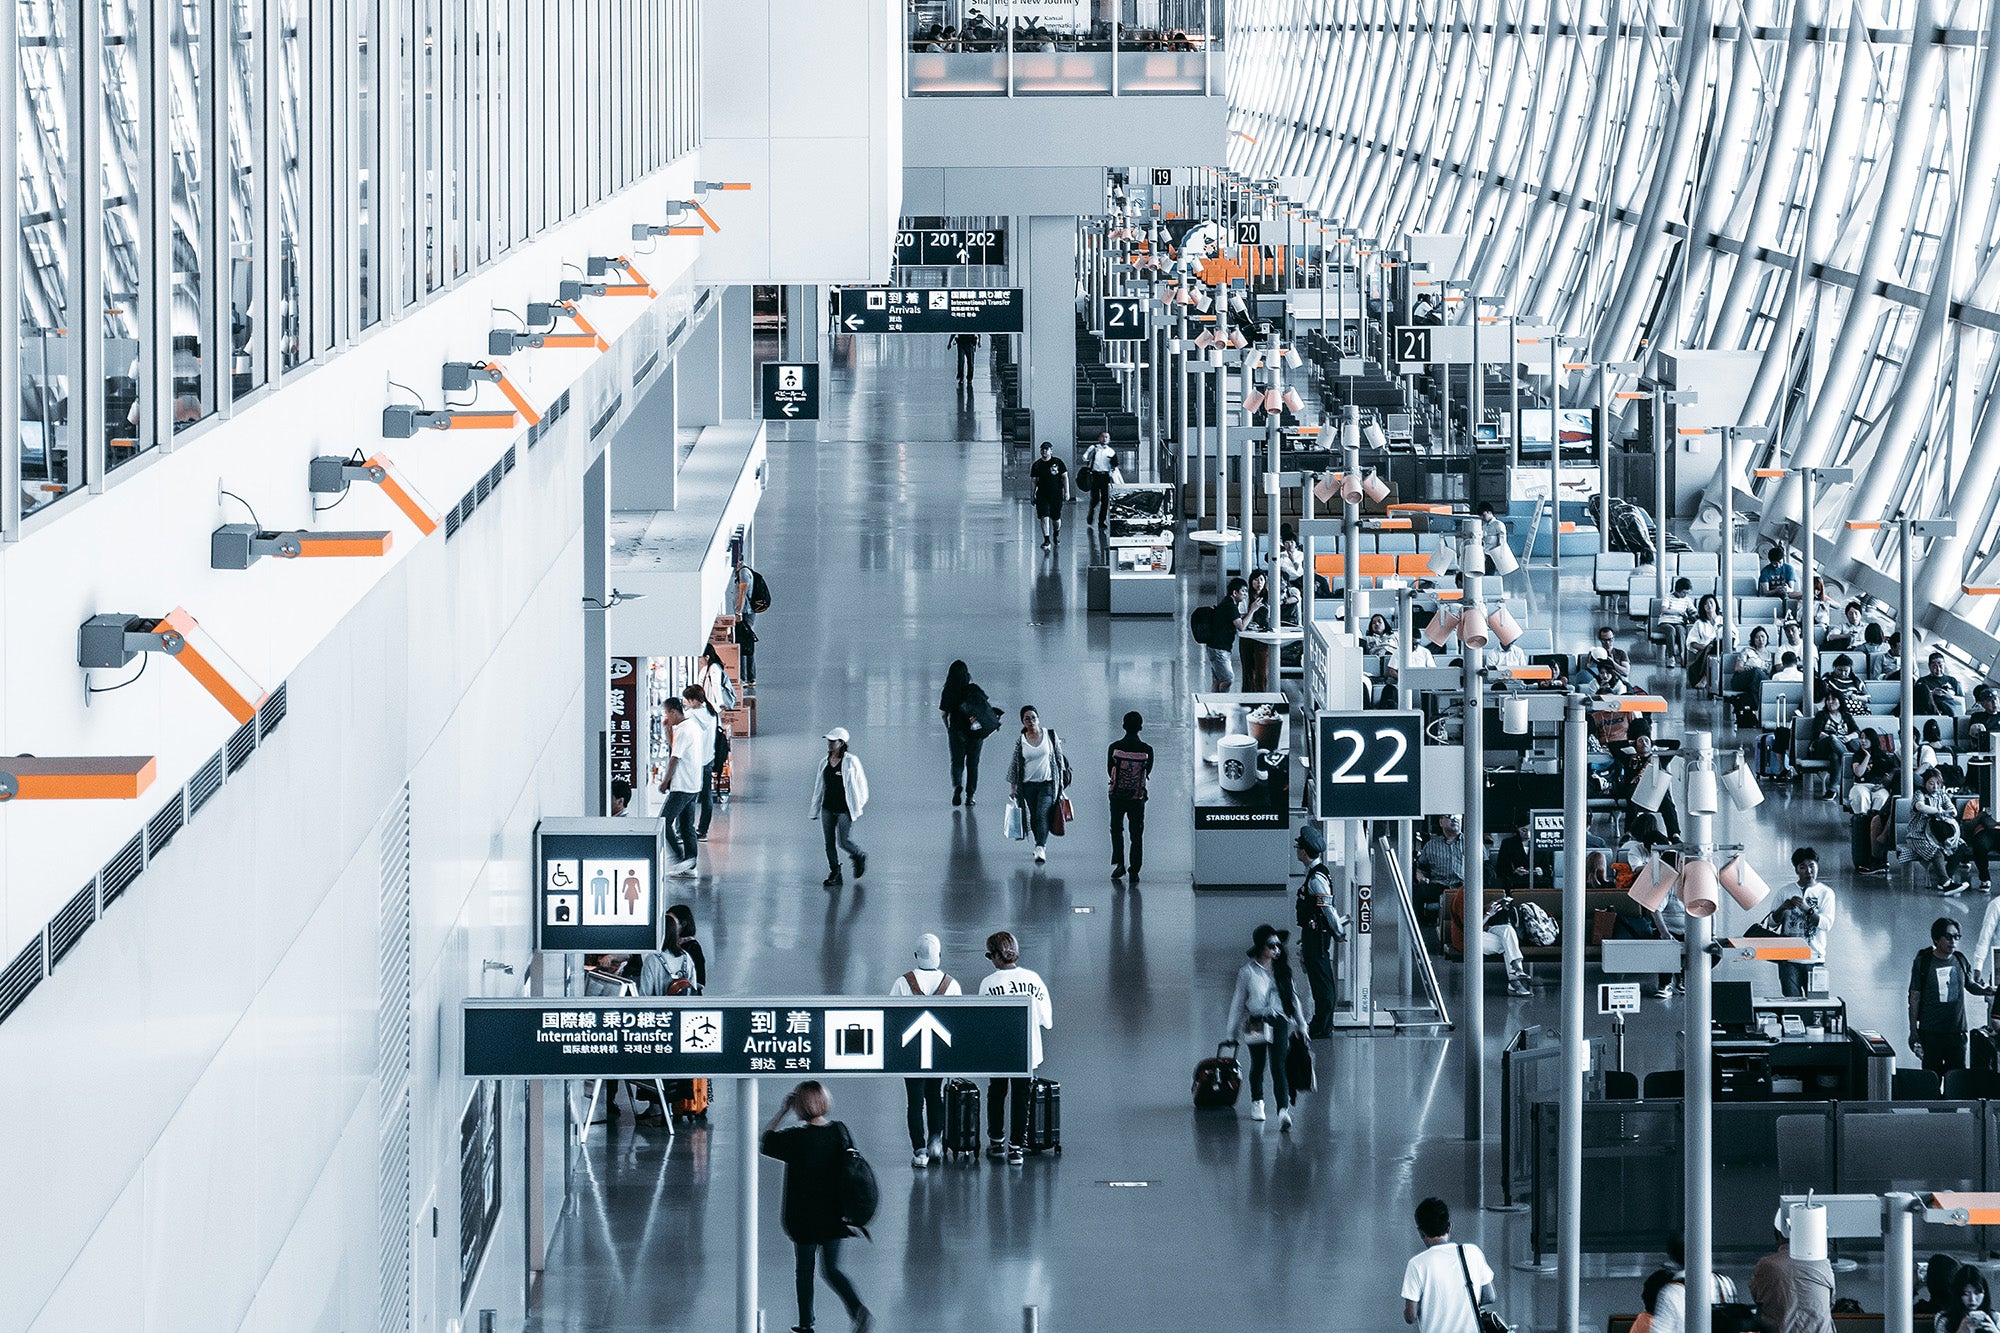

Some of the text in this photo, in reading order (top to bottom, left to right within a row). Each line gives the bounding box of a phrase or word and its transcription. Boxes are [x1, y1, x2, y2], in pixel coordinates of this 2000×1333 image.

[1157, 171, 1169, 184] 19
[1241, 224, 1257, 242] 20
[889, 305, 922, 314] Arrivals
[1109, 303, 1139, 327] 21
[1404, 332, 1425, 359] 21
[1332, 729, 1408, 784] 22
[1360, 901, 1370, 932] AED
[542, 1012, 673, 1029] 国際線 乗り継ぎ
[751, 1011, 812, 1034] 到着
[536, 1029, 673, 1042] International Transfer
[623, 1044, 652, 1054] 국제선
[743, 1036, 812, 1053] Arrivals
[750, 1058, 811, 1070] 到达 도착
